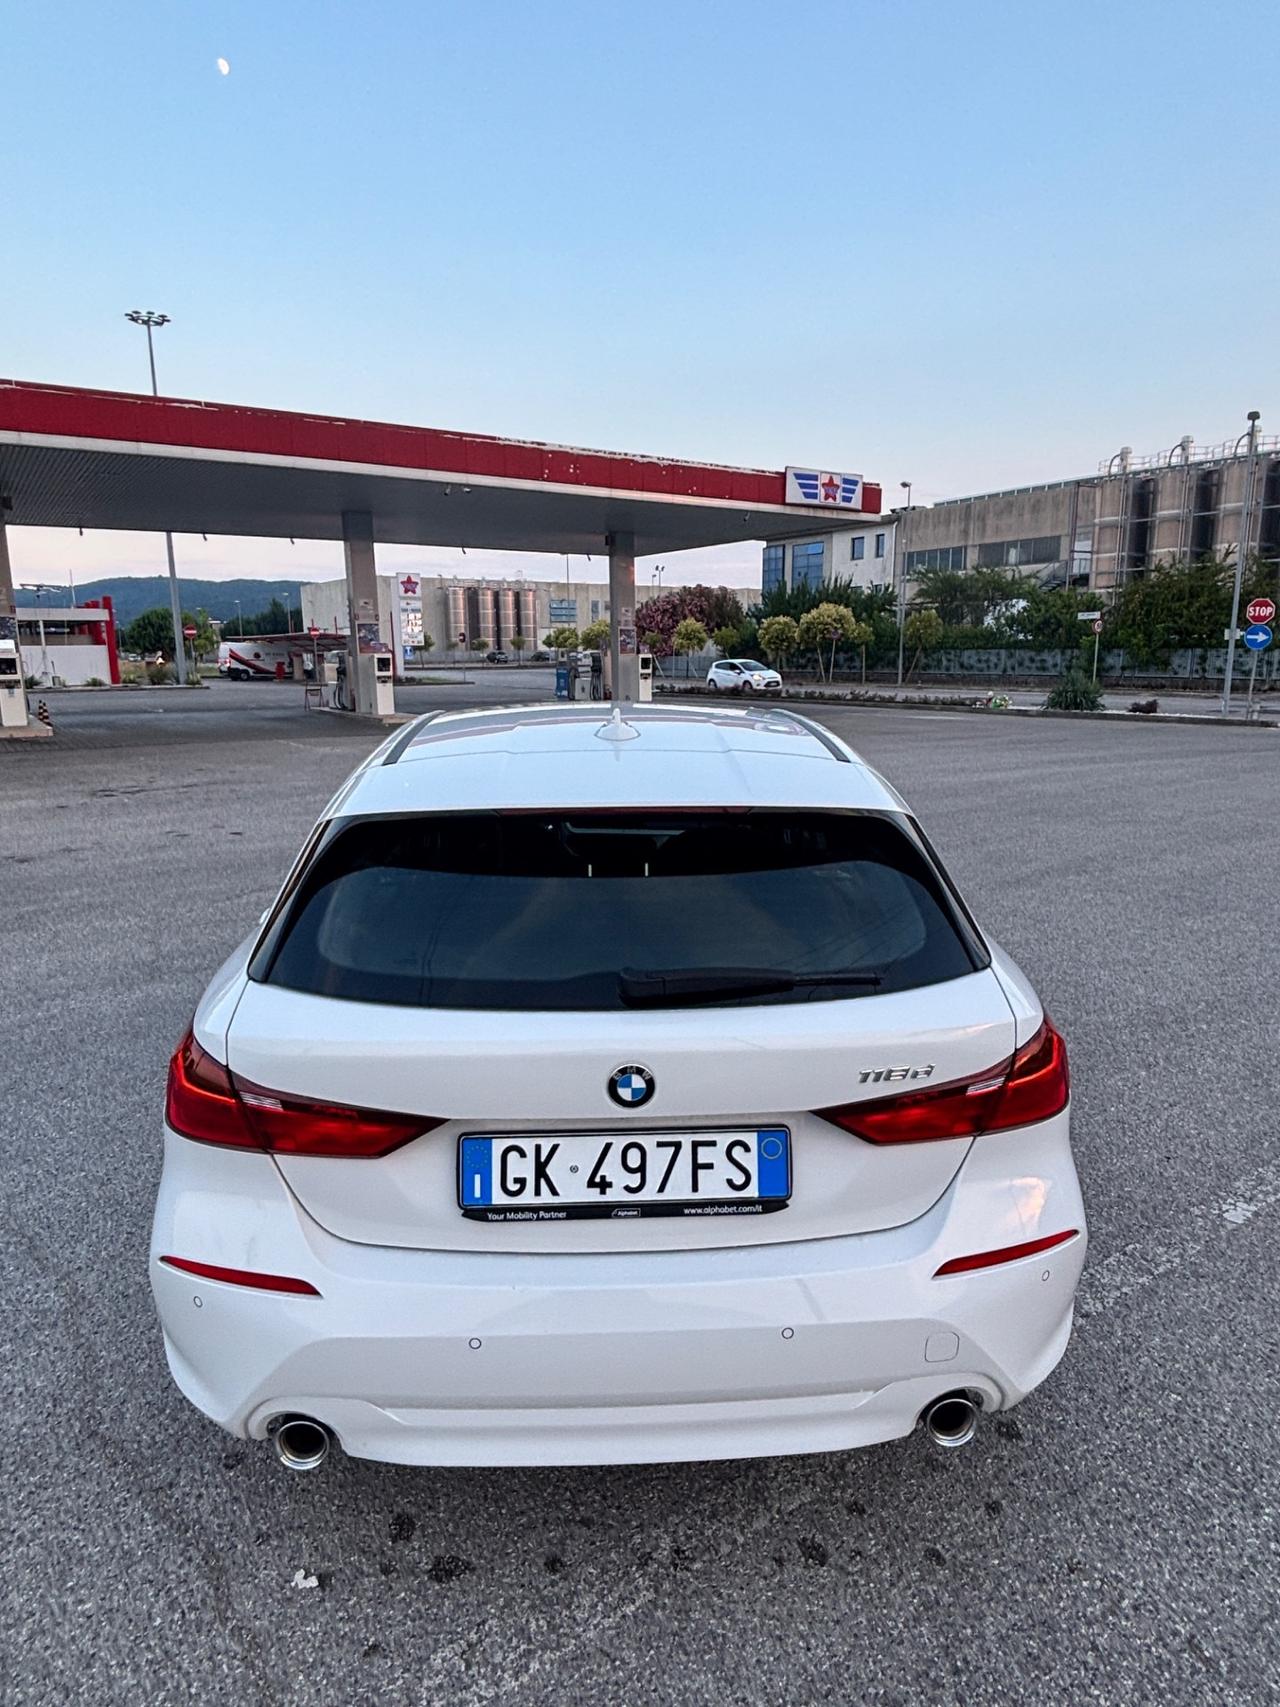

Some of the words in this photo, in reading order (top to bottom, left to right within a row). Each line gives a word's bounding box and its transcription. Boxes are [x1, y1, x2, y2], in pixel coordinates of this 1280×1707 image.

[1249, 606, 1273, 617] STOP
[613, 1066, 652, 1080] BMW
[859, 1063, 936, 1083] 118d
[500, 1143, 560, 1197] GK
[587, 1139, 752, 1195] 497FS
[487, 1212, 505, 1220] Your
[506, 1210, 537, 1221] Mobility
[539, 1210, 567, 1219] Partner
[683, 1204, 763, 1216] www.alphabet.com/it
